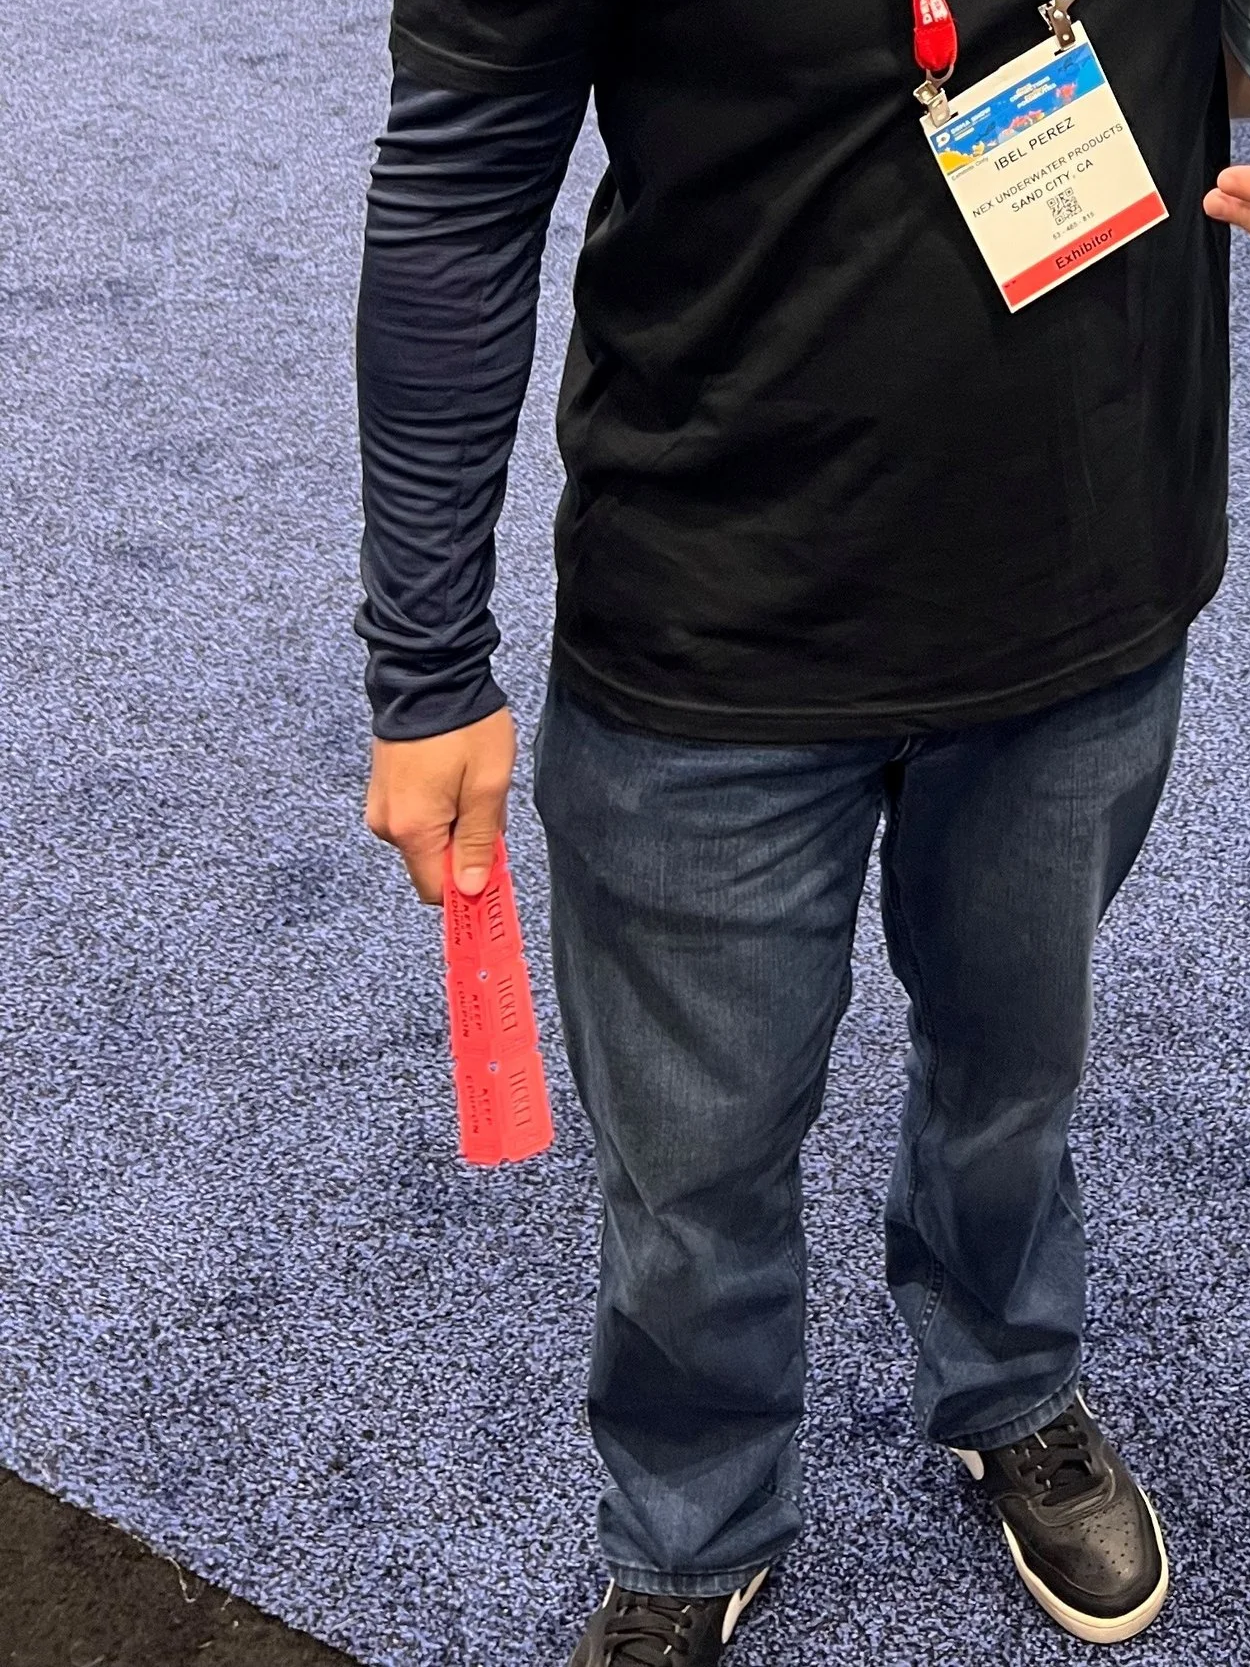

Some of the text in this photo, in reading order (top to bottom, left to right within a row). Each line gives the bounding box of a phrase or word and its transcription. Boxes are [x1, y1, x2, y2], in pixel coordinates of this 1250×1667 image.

[971, 200, 997, 219] NEX
[995, 156, 1068, 204] UNDERWATER
[1067, 123, 1124, 161] PRODUCTS
[993, 117, 1076, 171] IBEL PEREZ
[1011, 187, 1044, 213] SAND
[1076, 158, 1094, 173] CA
[1055, 228, 1114, 270] Exhibitor
[486, 885, 506, 942] TICKET
[497, 973, 520, 1033] TICKET
[509, 1066, 533, 1128] TICKET
